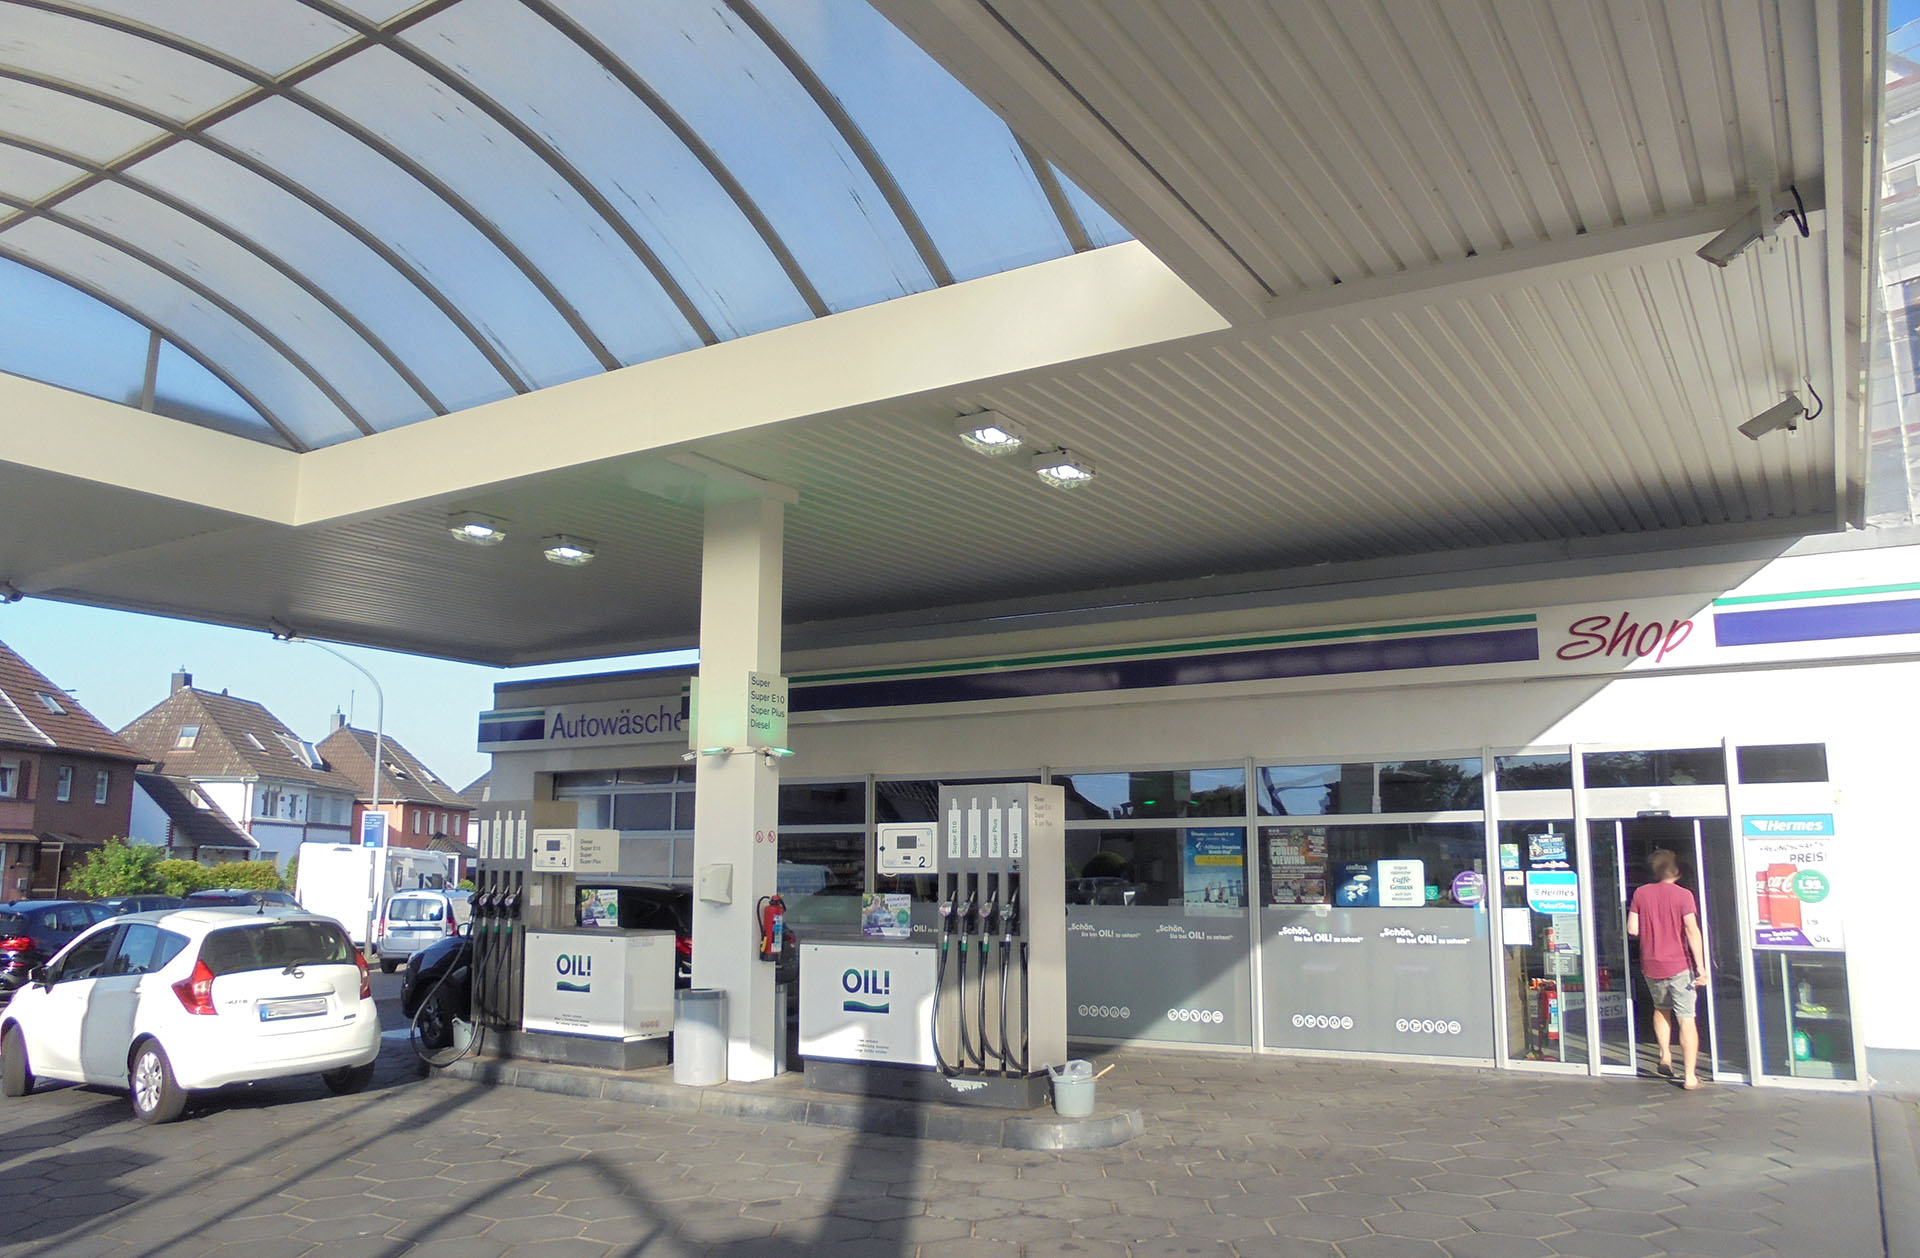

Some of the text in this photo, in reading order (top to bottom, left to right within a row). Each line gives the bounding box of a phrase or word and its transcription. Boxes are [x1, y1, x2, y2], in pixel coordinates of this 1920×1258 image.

[1556, 611, 1694, 663] Shop
[751, 676, 771, 687] Super
[750, 690, 785, 704] Super E10
[750, 704, 785, 718] Super Plus
[550, 705, 682, 739] Autowäsche
[750, 719, 771, 729] Diesel
[1767, 820, 1824, 831] Hermes
[951, 834, 959, 855] Super
[1272, 847, 1299, 856] PUBLIC
[561, 857, 567, 867] 4
[918, 856, 926, 868] 2
[1272, 856, 1305, 864] VIEWING
[1541, 888, 1574, 896] Hermes
[1098, 929, 1114, 938] OIL!
[1188, 931, 1205, 940] OIL!
[1314, 933, 1332, 942] OIL!
[1418, 934, 1437, 944] OIL!
[556, 954, 592, 976] OIL!
[842, 969, 890, 994] OIL!
